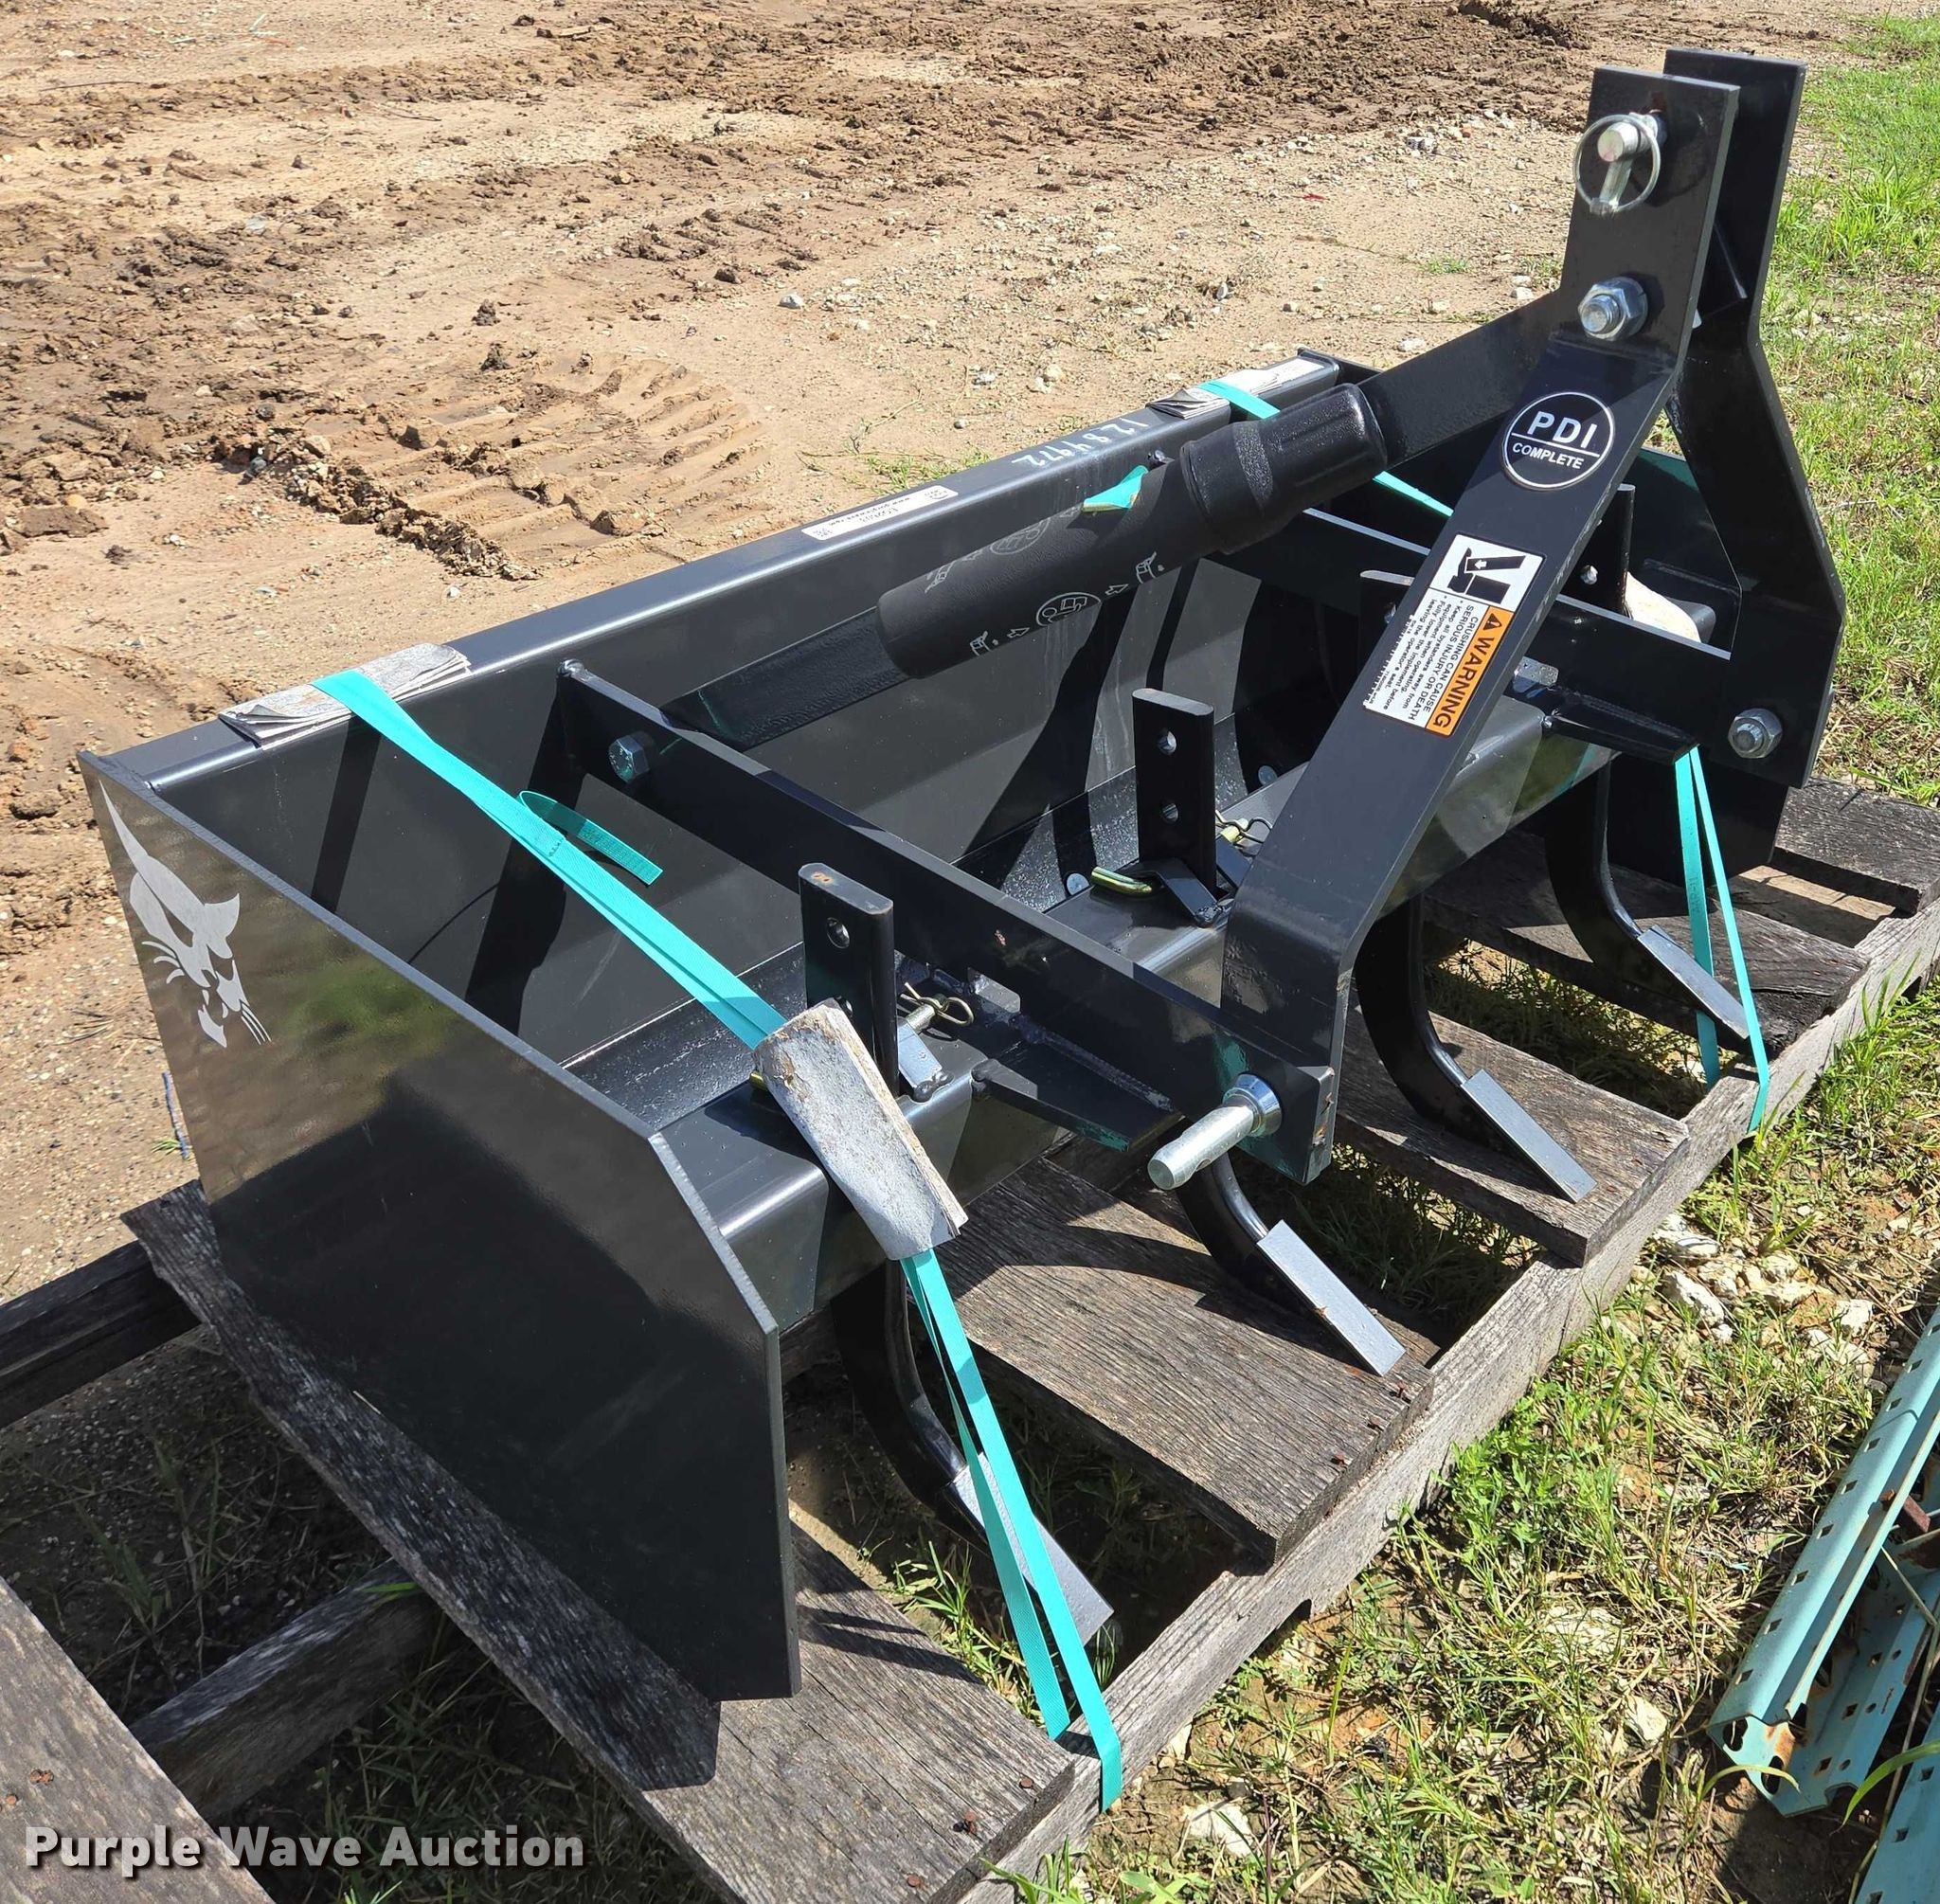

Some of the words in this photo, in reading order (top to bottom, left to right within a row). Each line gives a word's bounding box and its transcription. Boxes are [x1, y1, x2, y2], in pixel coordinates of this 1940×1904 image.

[1527, 410, 1598, 449] PDI
[1512, 441, 1585, 469] COMPLETE
[1419, 599, 1438, 623] leaving
[1429, 603, 1452, 639] equipment
[1431, 600, 1446, 618] Fully
[1448, 605, 1462, 622] Keep
[1413, 624, 1424, 636] the
[1422, 619, 1436, 638] lower
[1449, 604, 1475, 643] SERIOUS
[1414, 639, 1425, 651] the
[1420, 640, 1433, 658] when
[1449, 616, 1479, 661] CRUSHING
[1422, 634, 1446, 672] bystanders
[1432, 643, 1454, 675] INJURY
[1394, 652, 1418, 687] implement
[1439, 662, 1454, 682] CAN
[1410, 674, 1425, 692] away
[1424, 676, 1436, 690] OR
[1432, 638, 1495, 728] WARNING
[1383, 688, 1398, 710] before
[1402, 692, 1415, 710] from
[1408, 691, 1429, 721] DEATH
[1422, 682, 1444, 713] CAUSE
